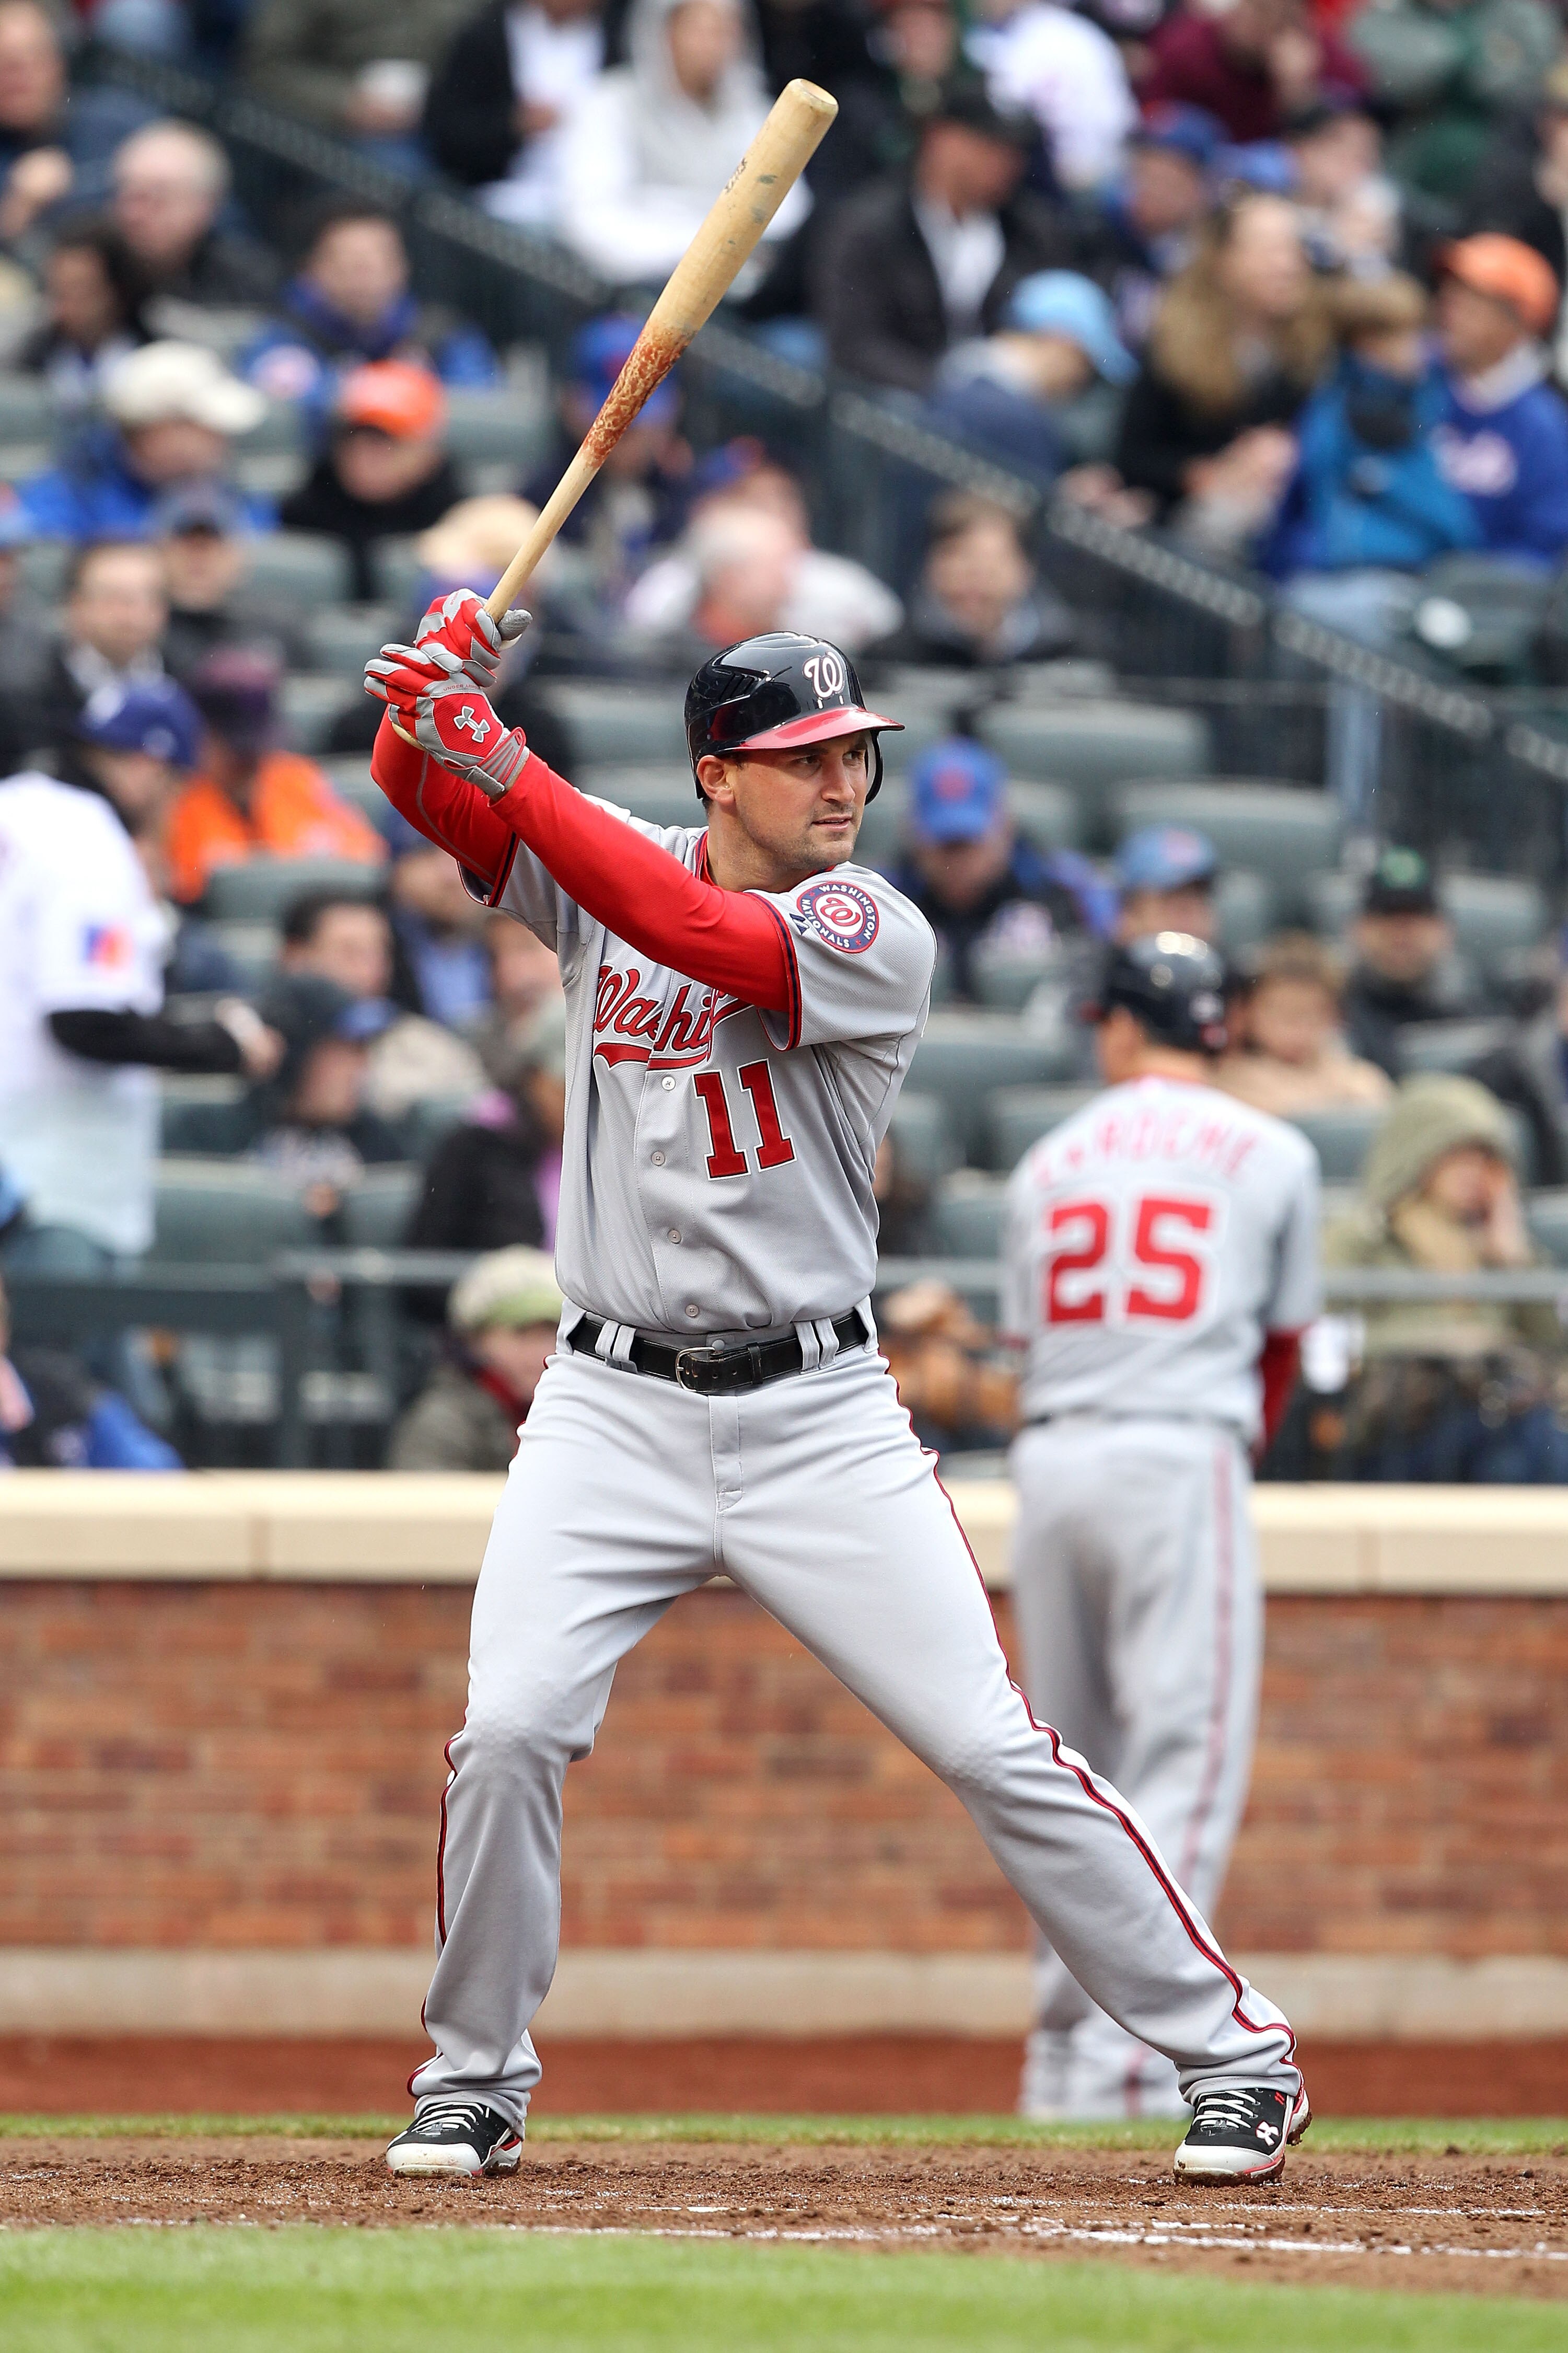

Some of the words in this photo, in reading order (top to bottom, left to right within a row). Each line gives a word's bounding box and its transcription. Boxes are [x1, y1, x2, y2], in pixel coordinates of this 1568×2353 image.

[802, 651, 845, 699] W
[801, 898, 850, 948] NATIONALS
[818, 884, 876, 940] WASHINGTON
[594, 965, 718, 1053] Washi
[692, 1058, 797, 1180] 11
[1046, 1198, 1211, 1325] 25
